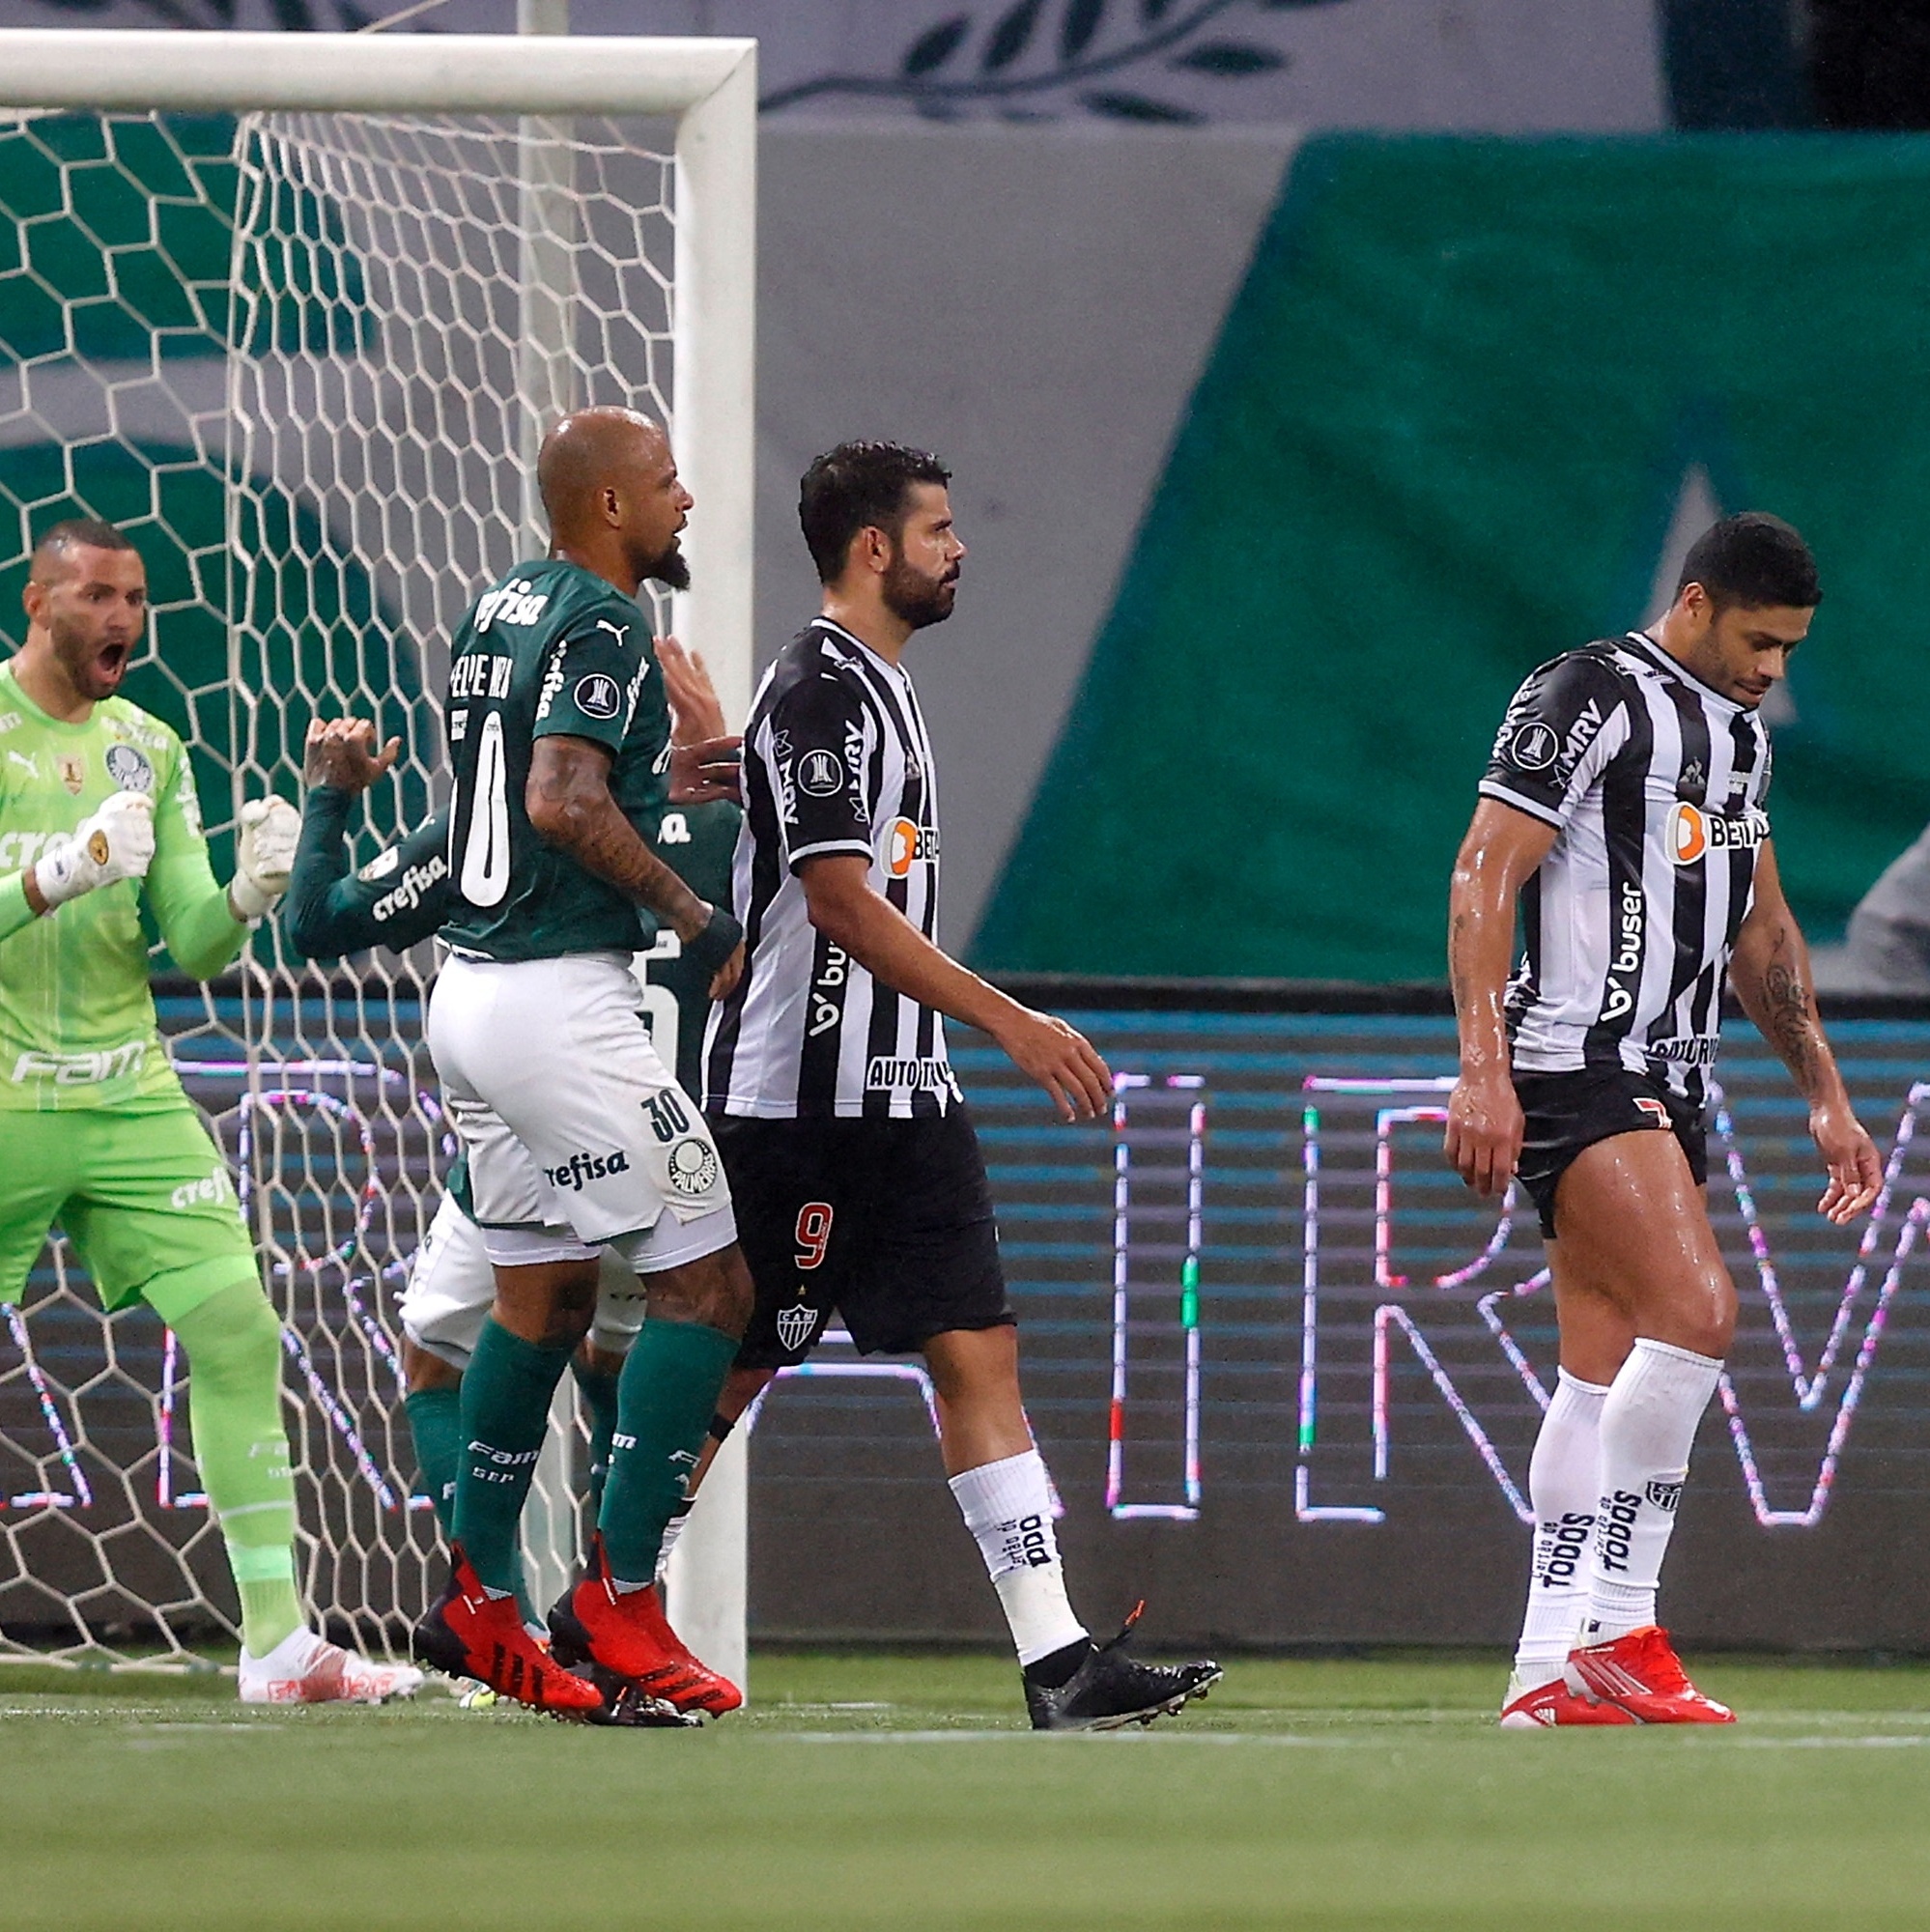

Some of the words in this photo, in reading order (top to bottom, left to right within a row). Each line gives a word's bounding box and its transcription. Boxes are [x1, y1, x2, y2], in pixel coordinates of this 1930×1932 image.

[1559, 697, 1603, 769] MRV
[372, 855, 448, 922] crefisa
[1611, 881, 1642, 972] buser
[639, 1089, 691, 1143] 30
[543, 1151, 630, 1192] refisa
[671, 1152, 717, 1194] PALMEIRAS
[794, 1202, 834, 1270] 9
[1542, 1512, 1596, 1588] TODOS
[1603, 1490, 1643, 1573] TODOS
